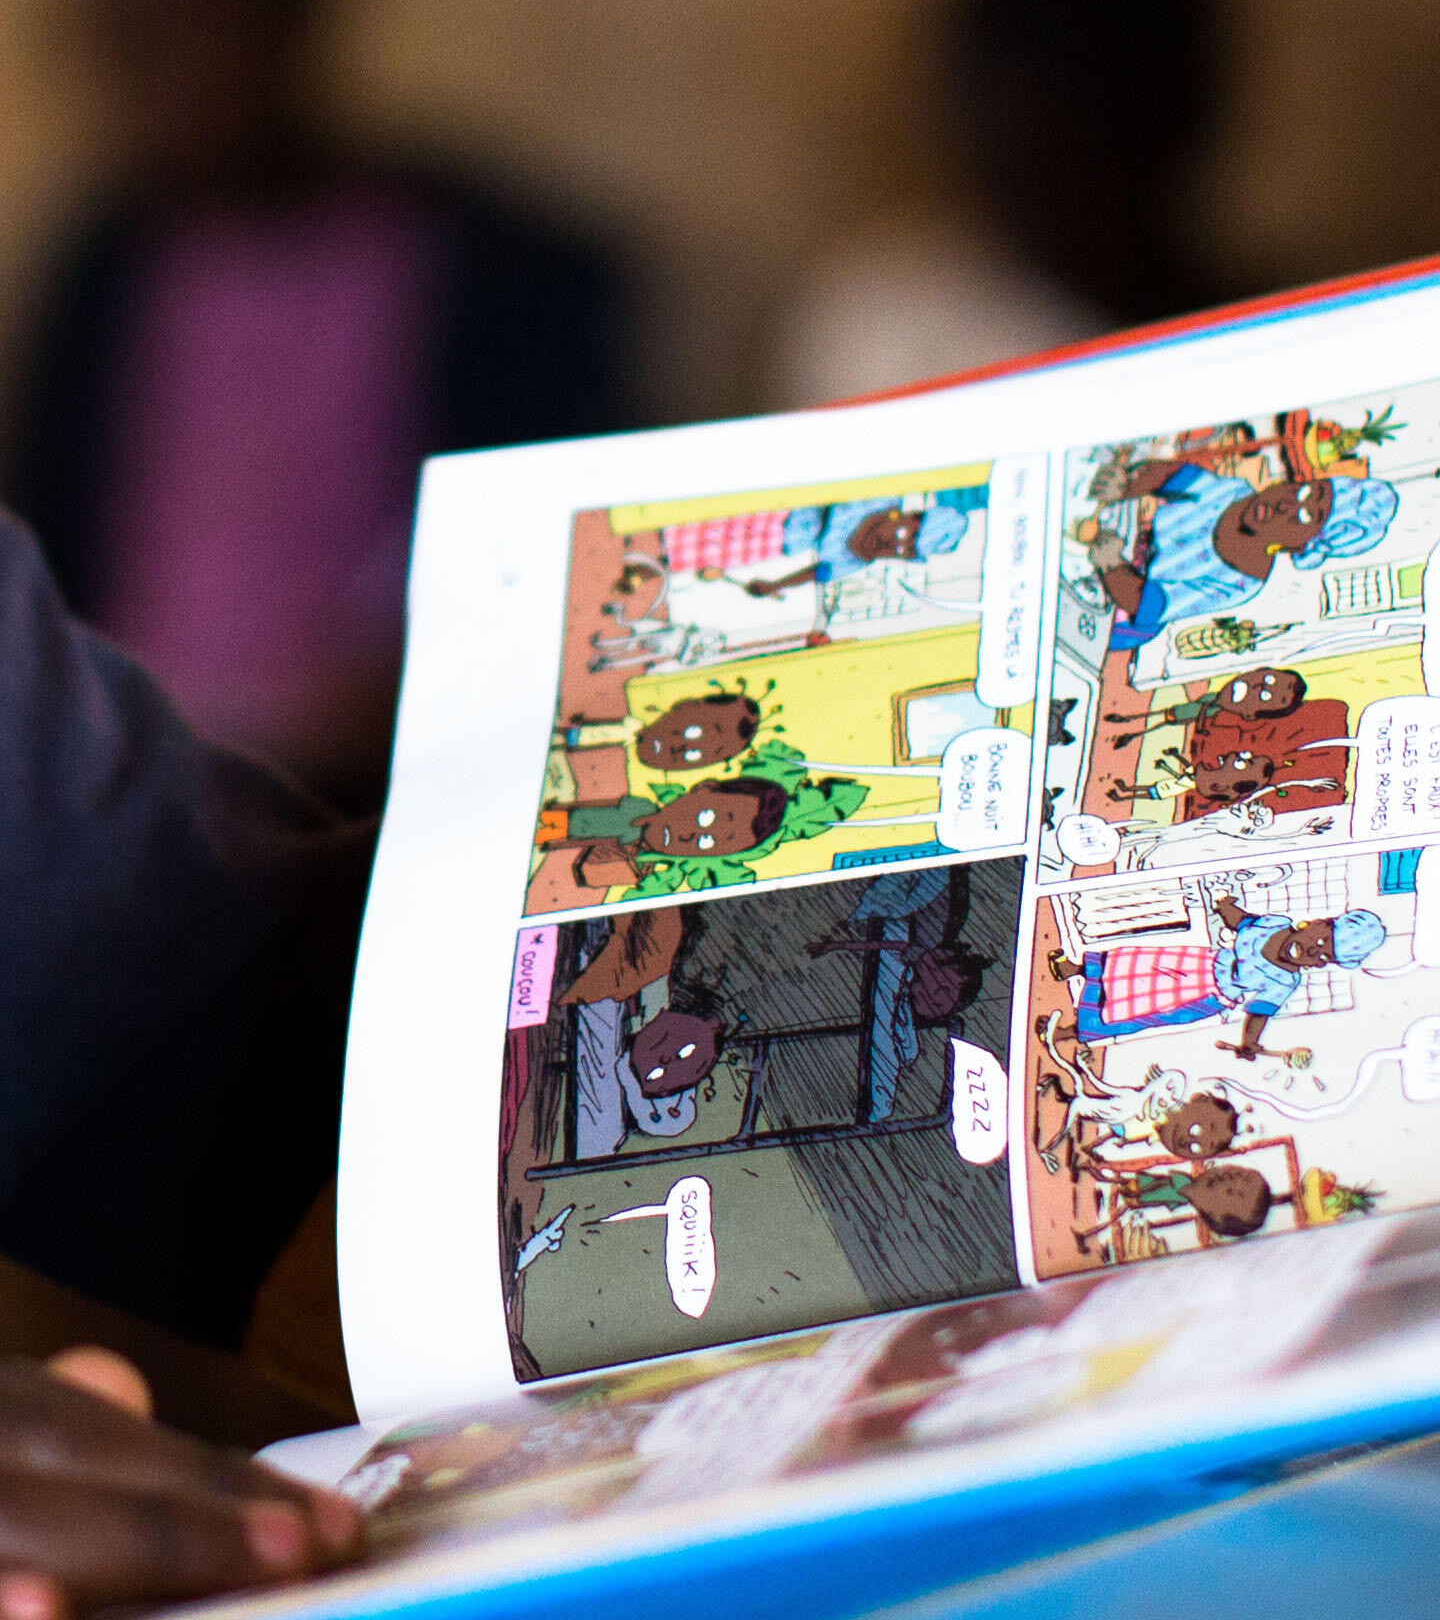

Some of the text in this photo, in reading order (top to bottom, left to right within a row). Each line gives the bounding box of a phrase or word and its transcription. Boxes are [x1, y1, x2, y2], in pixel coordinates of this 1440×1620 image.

[1375, 715, 1393, 765] TOUTES
[988, 743, 1009, 793] BONNE
[1402, 723, 1419, 815] ELLES SONT
